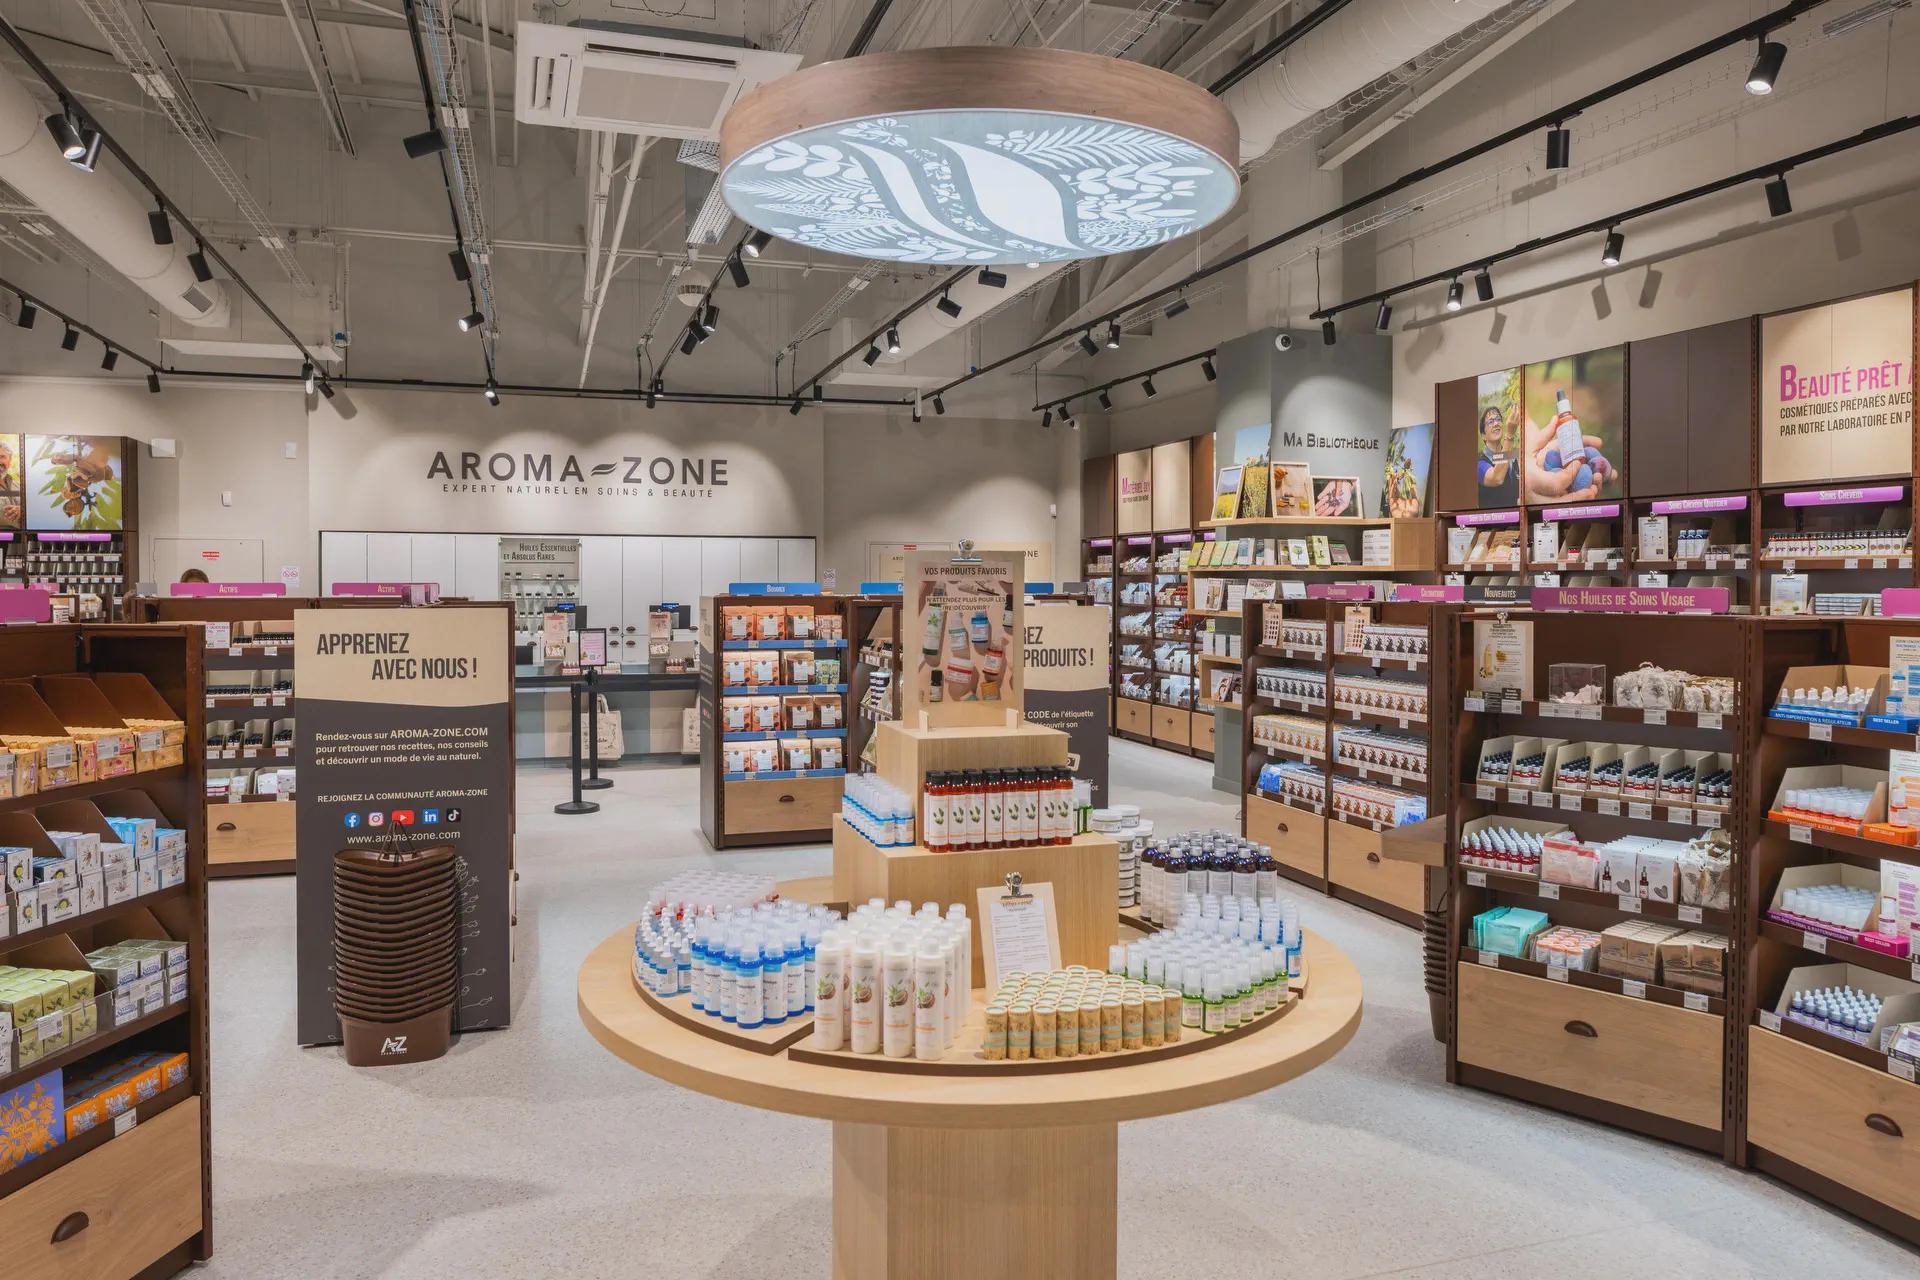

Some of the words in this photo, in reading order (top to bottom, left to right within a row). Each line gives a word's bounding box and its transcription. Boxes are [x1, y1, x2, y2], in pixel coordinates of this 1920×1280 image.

[1780, 364, 1852, 402] BEAUTÉ
[1857, 360, 1902, 392] PRÊT
[1780, 401, 1839, 420] COSMÉTIQUES
[1840, 393, 1886, 412] PRÉPARÉS
[1888, 391, 1912, 406] AVEC
[1780, 424, 1796, 437] PAR
[1798, 420, 1825, 435] NOTRE
[1827, 413, 1888, 432] LABORATOIRE
[1890, 411, 1902, 425] EN
[1306, 433, 1380, 450] BIBLIOTHÈQUE
[427, 451, 585, 482] AROMA
[622, 456, 728, 485] ZONE
[442, 484, 497, 493] EXPERT
[506, 485, 568, 495] NATUREL
[574, 486, 588, 495] EN
[597, 487, 638, 496] SOINS
[648, 488, 654, 496] &
[663, 487, 713, 497] BEAUTÉ
[924, 567, 939, 575] VOS
[940, 567, 976, 575] PRODUITS
[977, 567, 1007, 575] FAVORIS
[316, 632, 410, 655] APPRENEZ
[1024, 648, 1087, 668] PRODUITS
[1090, 647, 1094, 666] !
[372, 658, 417, 680] AVEC
[421, 657, 468, 680] NOUS
[472, 657, 477, 679] !
[1027, 710, 1050, 719] CODE
[1061, 710, 1094, 719] l'étiquette
[315, 732, 373, 741] Rendez-vous
[374, 732, 388, 740] sur
[389, 727, 488, 739] AROMA-ZONE.COM
[315, 745, 336, 755] pour
[338, 744, 379, 753] retrouver
[380, 743, 396, 751] nos
[398, 741, 435, 751] recettes,
[437, 741, 453, 749] nos
[454, 739, 488, 749] conseils
[315, 757, 325, 765] et
[326, 756, 369, 765] découvrir
[383, 754, 408, 763] mode
[409, 754, 421, 762] de
[422, 753, 435, 761] vie
[449, 751, 482, 760] naturel.
[317, 793, 363, 803] REJOIGNEZ
[364, 793, 375, 801] LA
[376, 789, 434, 801] COMMUNAUTÉ
[435, 788, 488, 798] AROMA-ZONE
[346, 830, 461, 844] www.aroma-zone.com
